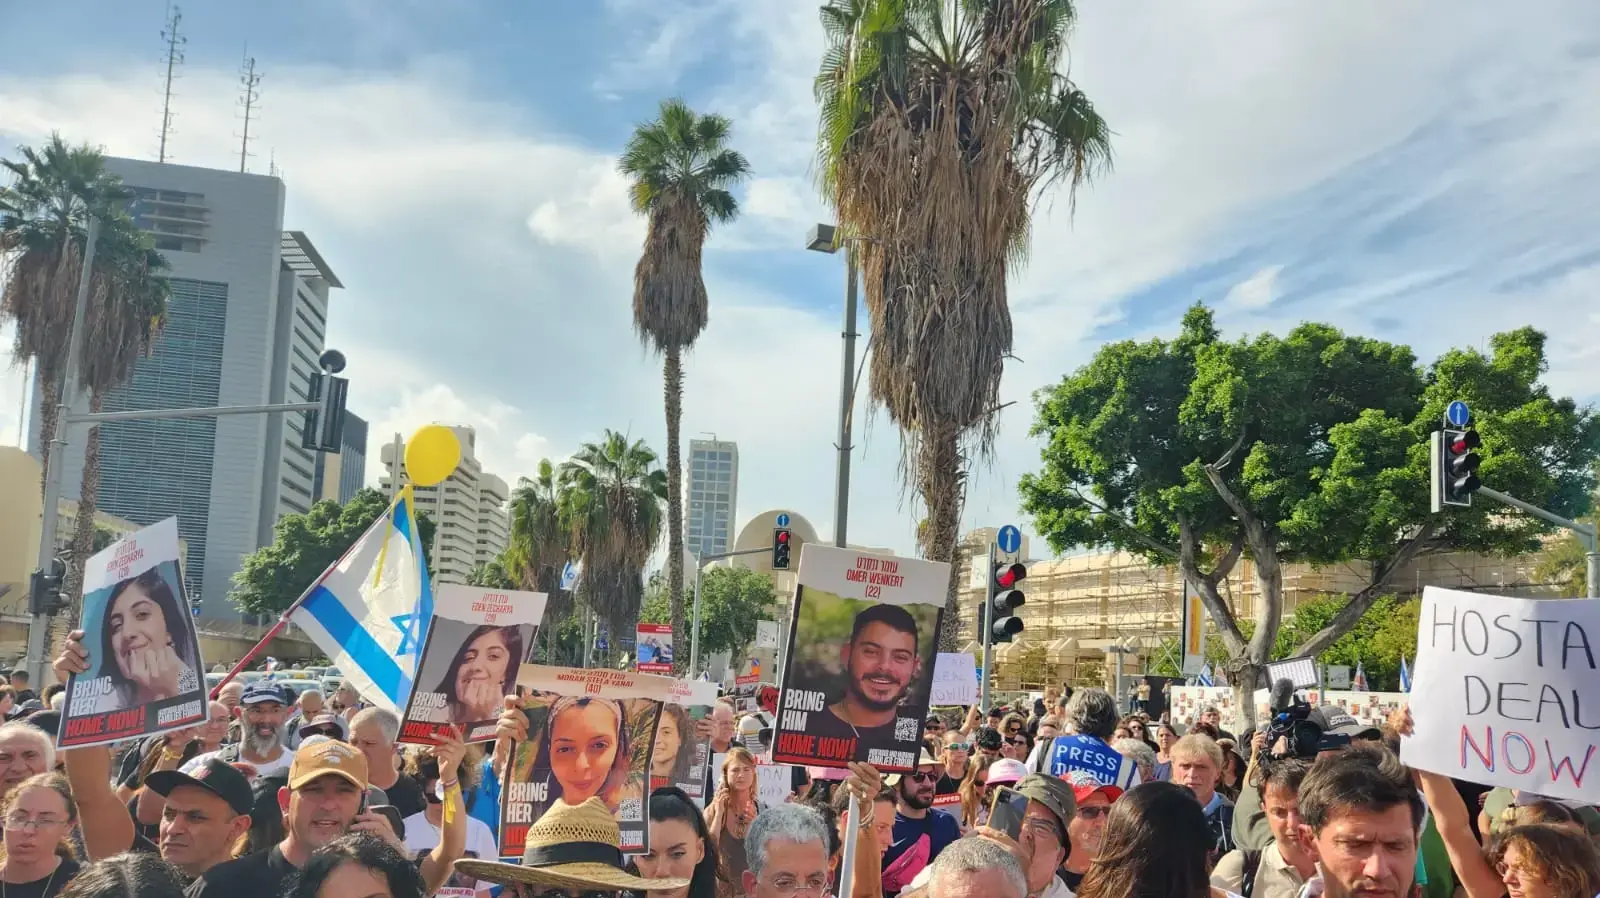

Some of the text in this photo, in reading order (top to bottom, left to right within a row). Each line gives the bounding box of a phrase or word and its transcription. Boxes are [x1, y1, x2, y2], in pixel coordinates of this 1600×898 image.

[847, 569, 904, 587] OMER WENKERT
[865, 585, 881, 599] (22)
[73, 676, 112, 698] BRING
[556, 674, 585, 682] MORAN
[585, 683, 602, 695] (40)
[69, 699, 97, 717] HER
[413, 692, 447, 708] BRING
[785, 688, 825, 712] BRING
[1464, 675, 1600, 730] DEAL
[67, 715, 104, 737] HOME
[106, 706, 145, 730] NOW!
[408, 707, 431, 721] HER
[781, 709, 808, 731] HIM
[778, 733, 857, 759] HOME NOW!
[1460, 724, 1597, 789] NOW
[1056, 744, 1118, 771] PRESS
[508, 782, 549, 802] BRING
[506, 802, 533, 823] HER
